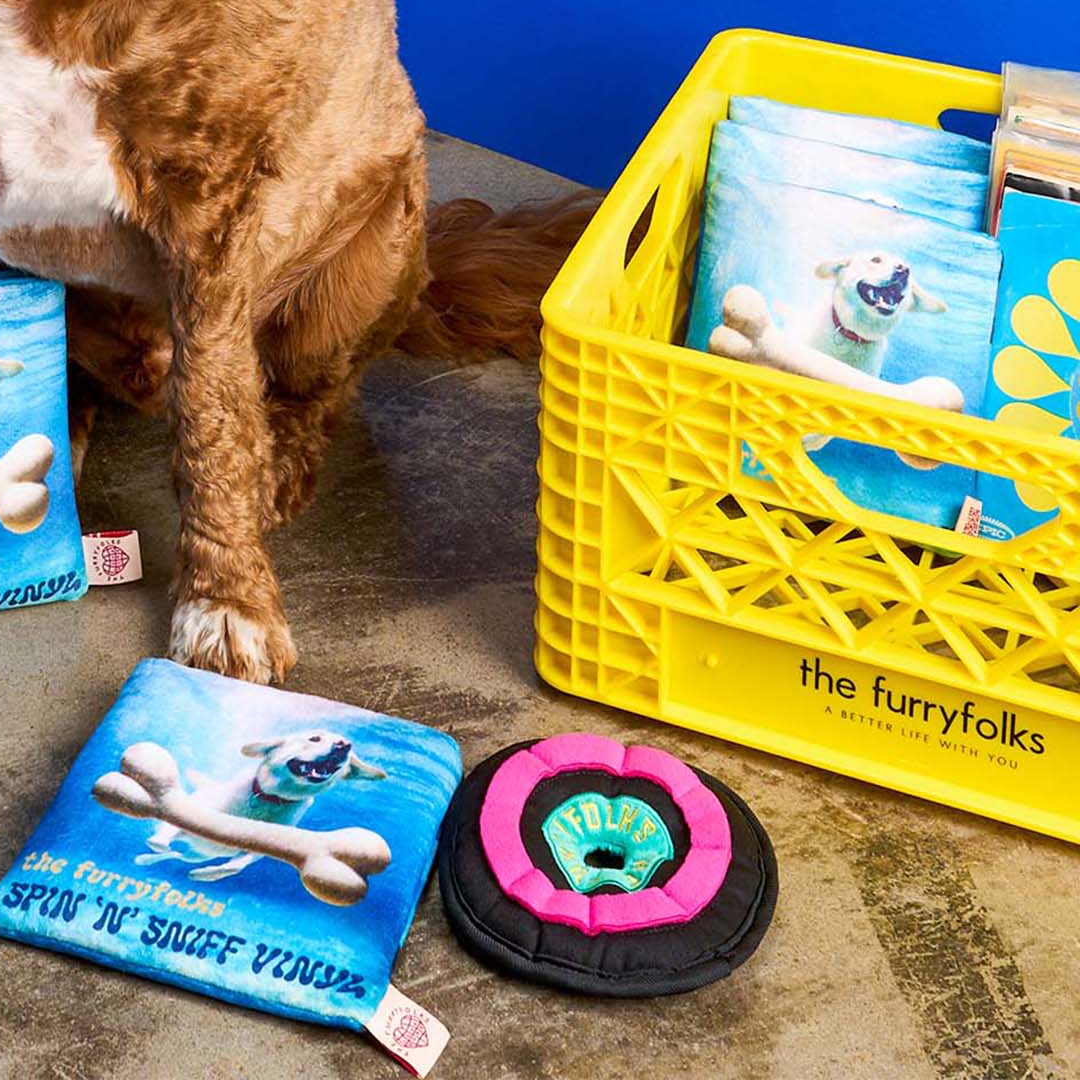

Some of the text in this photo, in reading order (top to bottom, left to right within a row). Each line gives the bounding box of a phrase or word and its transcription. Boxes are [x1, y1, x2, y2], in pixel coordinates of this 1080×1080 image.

[800, 658, 1046, 756] the furryfolks
[824, 705, 1019, 770] A BETTER LIFE WITH YOU
[22, 852, 226, 918] the furryfolks
[2, 882, 87, 921] SPIN
[140, 918, 247, 965] SNIFF
[251, 942, 367, 999] VINYL
